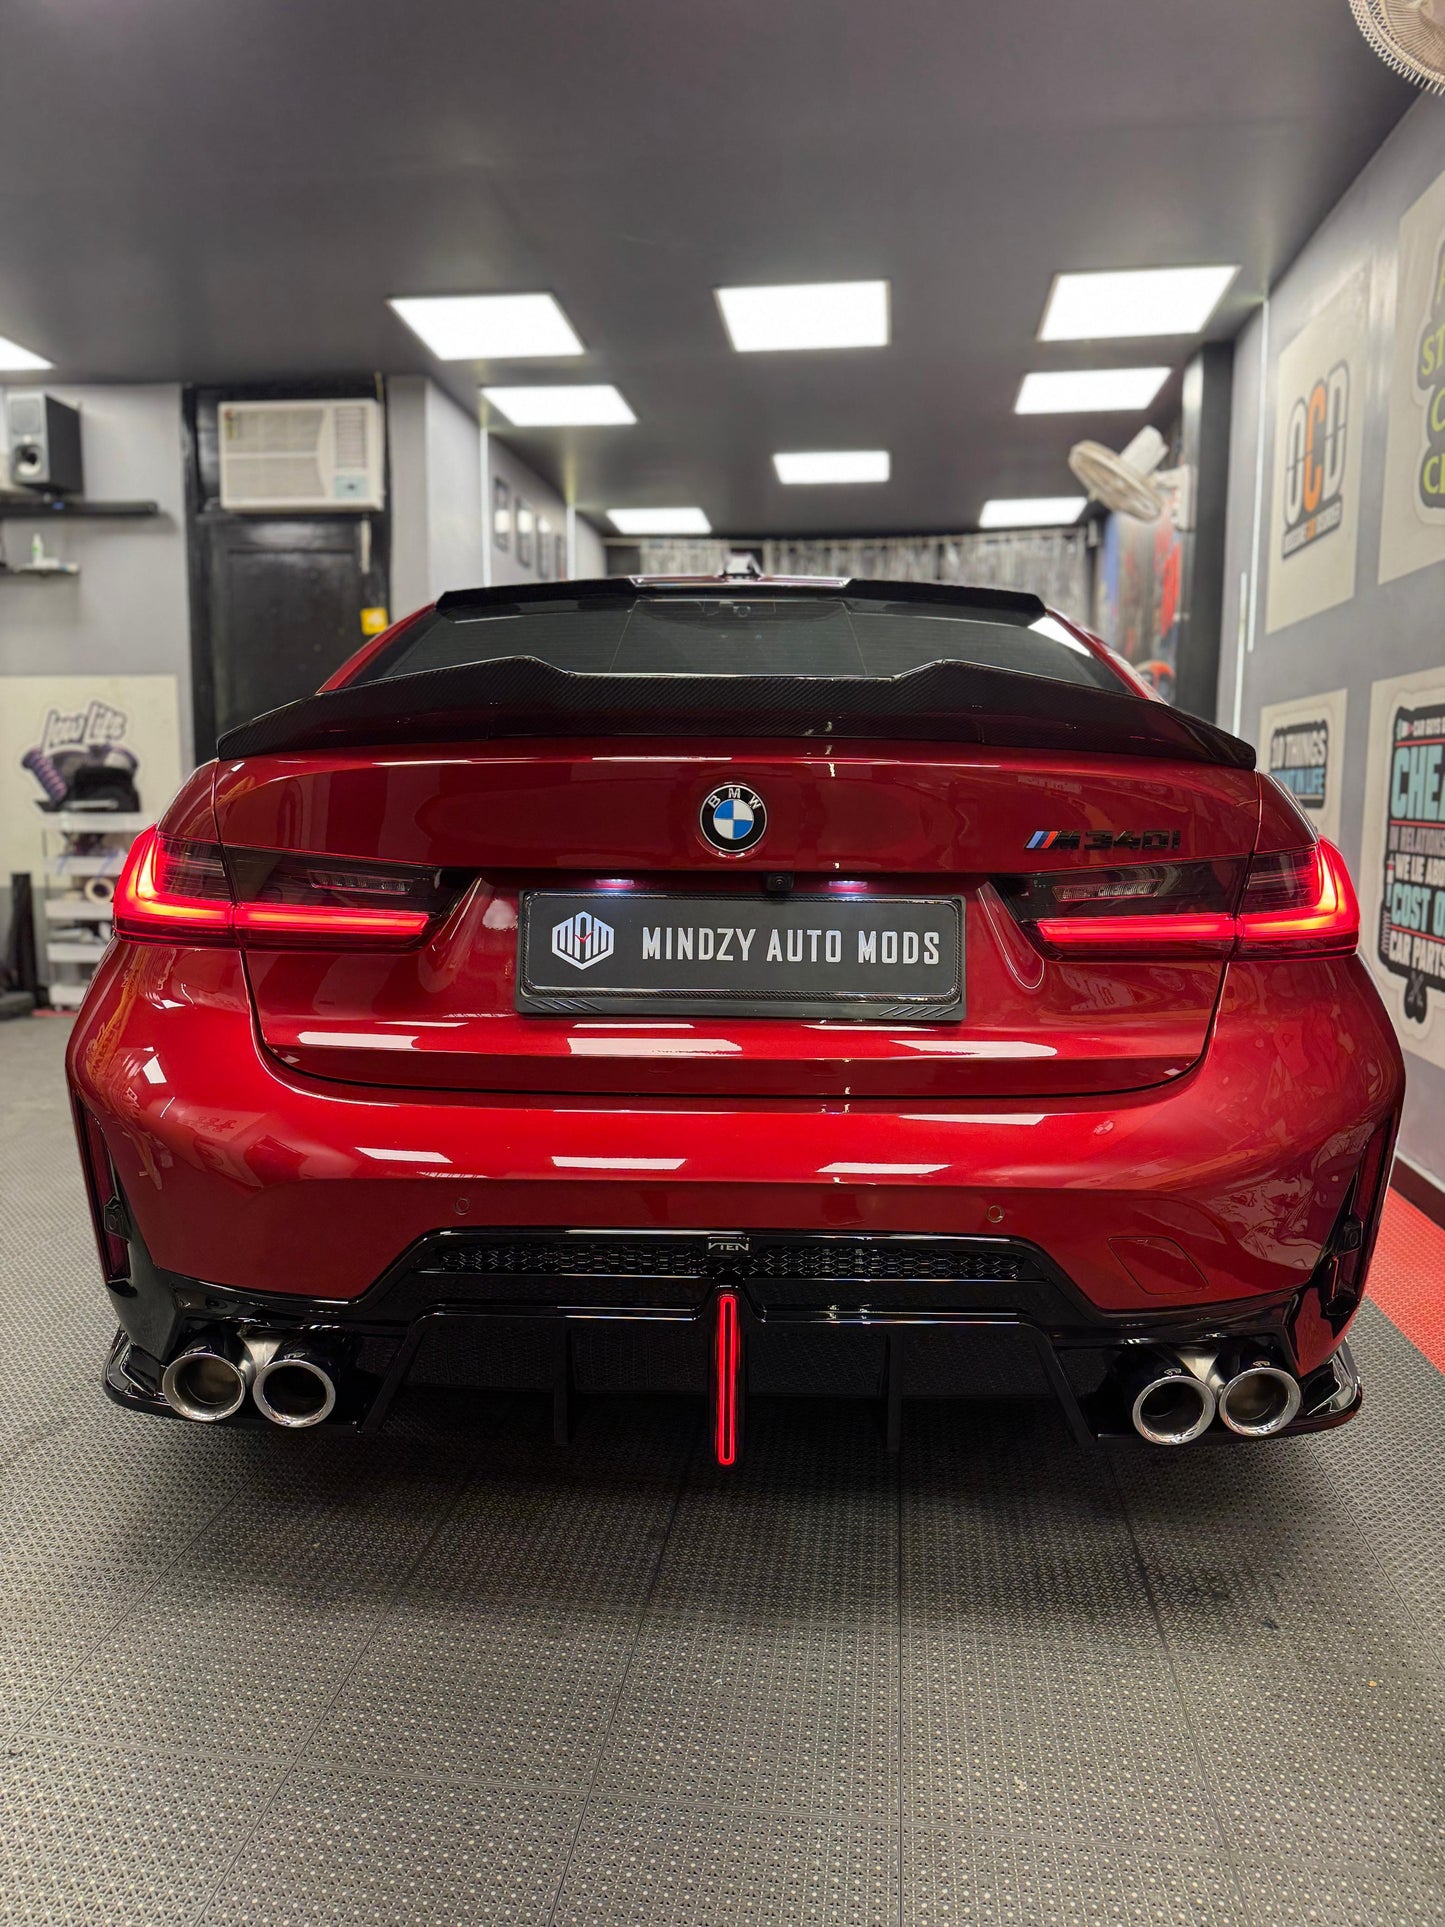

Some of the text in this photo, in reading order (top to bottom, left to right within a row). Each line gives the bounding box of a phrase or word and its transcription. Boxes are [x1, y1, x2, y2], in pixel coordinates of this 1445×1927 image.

[1285, 364, 1348, 527] OCD
[1285, 728, 1327, 768] THINGS
[707, 787, 762, 811] BMW
[1391, 743, 1445, 822] CHE
[1391, 882, 1432, 933] COST
[642, 926, 940, 965] MINDZY AUTO MODS
[1388, 930, 1412, 967] CAR
